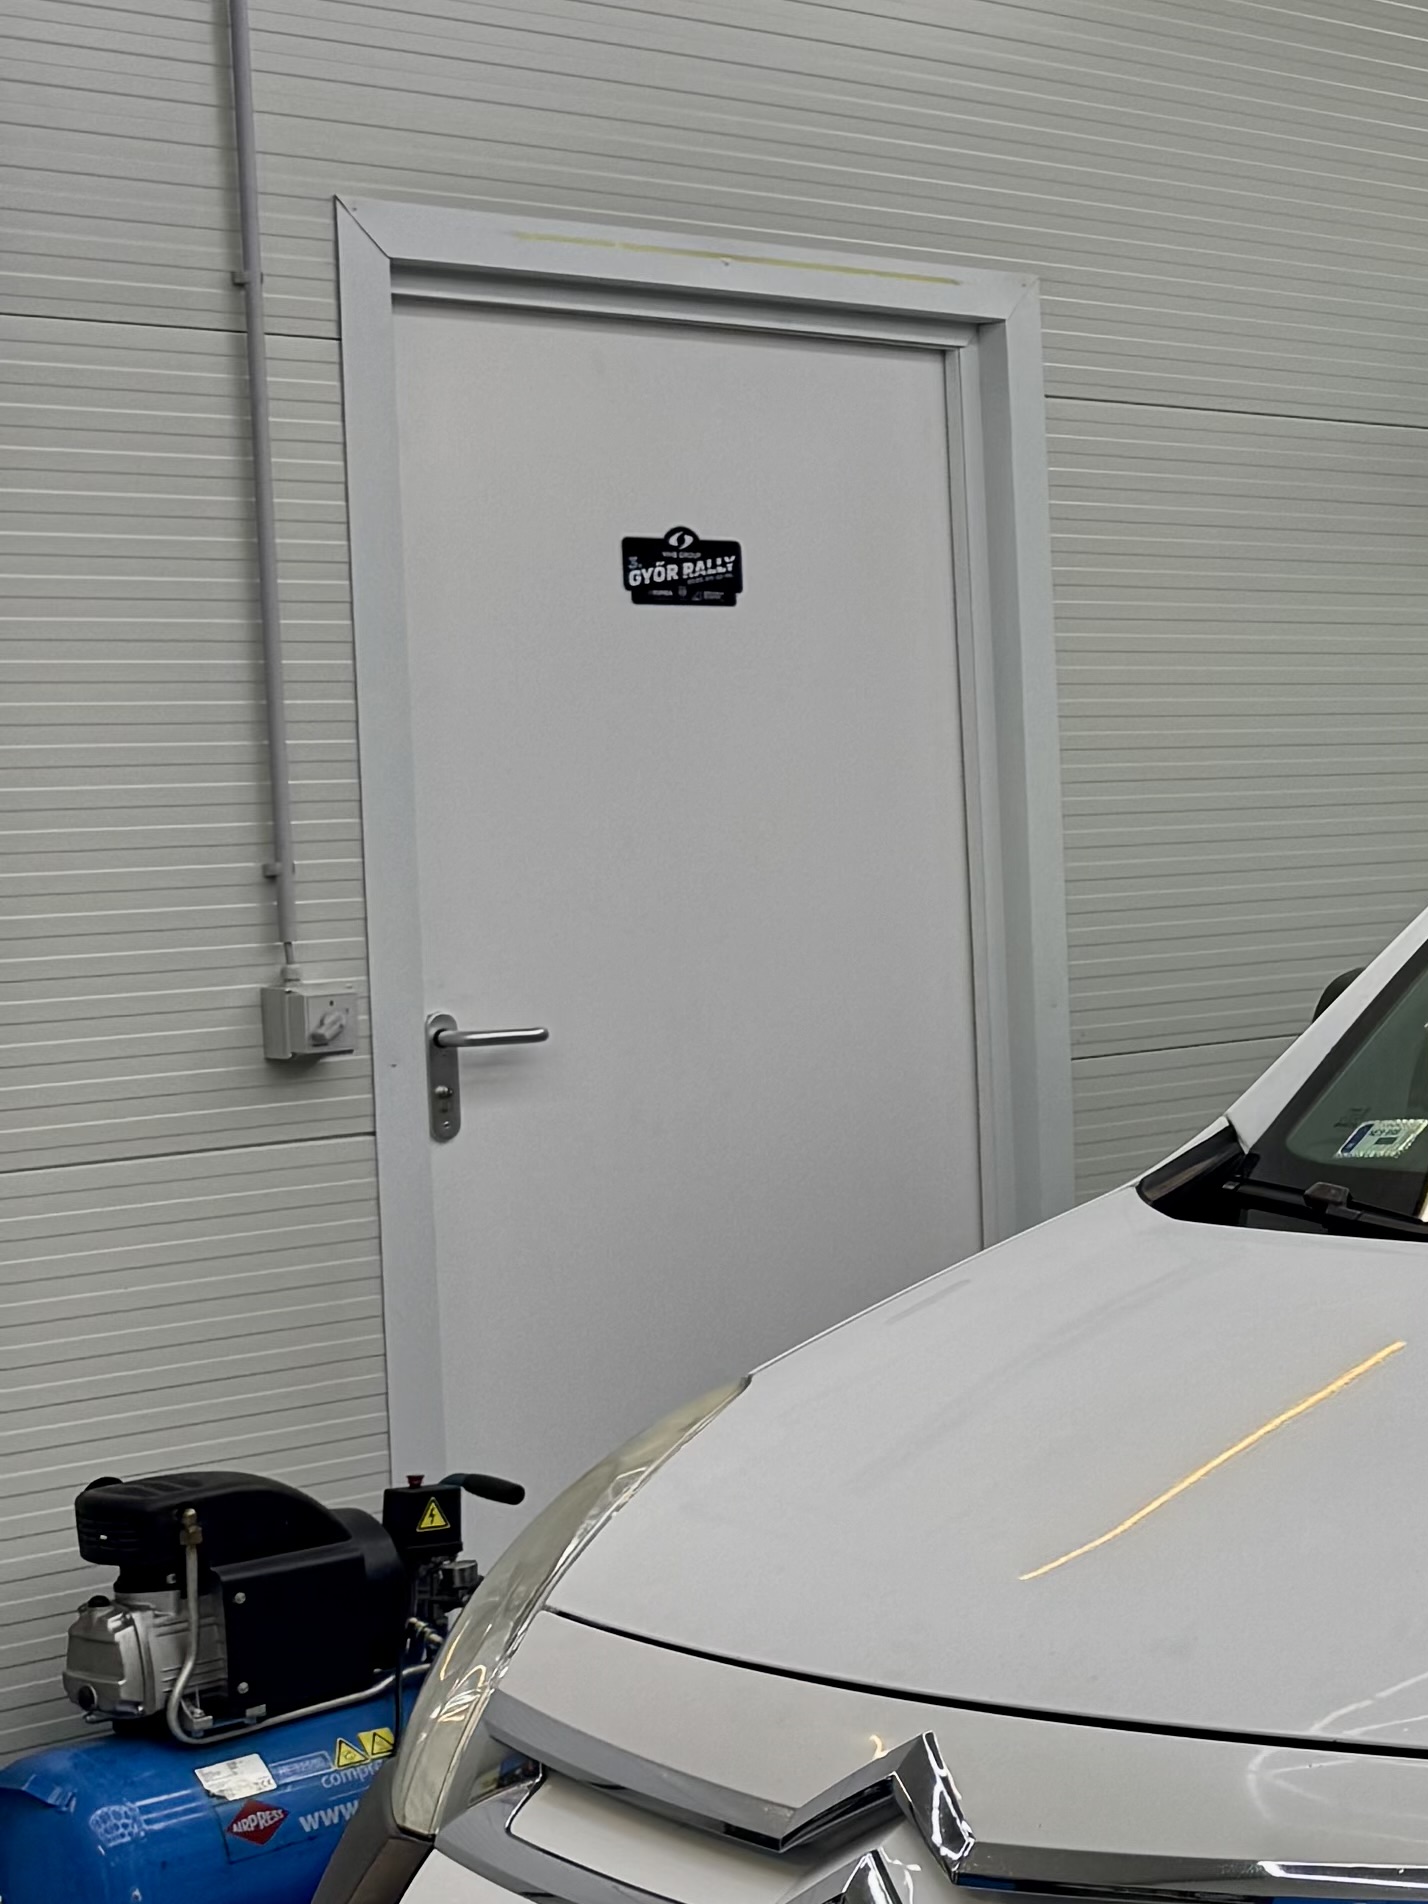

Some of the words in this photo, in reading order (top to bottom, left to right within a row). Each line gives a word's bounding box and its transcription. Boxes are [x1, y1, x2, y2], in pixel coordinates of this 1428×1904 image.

[628, 556, 643, 569] 3.
[628, 560, 679, 587] GYŐR
[682, 555, 736, 579] RALLY
[232, 1807, 284, 1834] AIRPRESS
